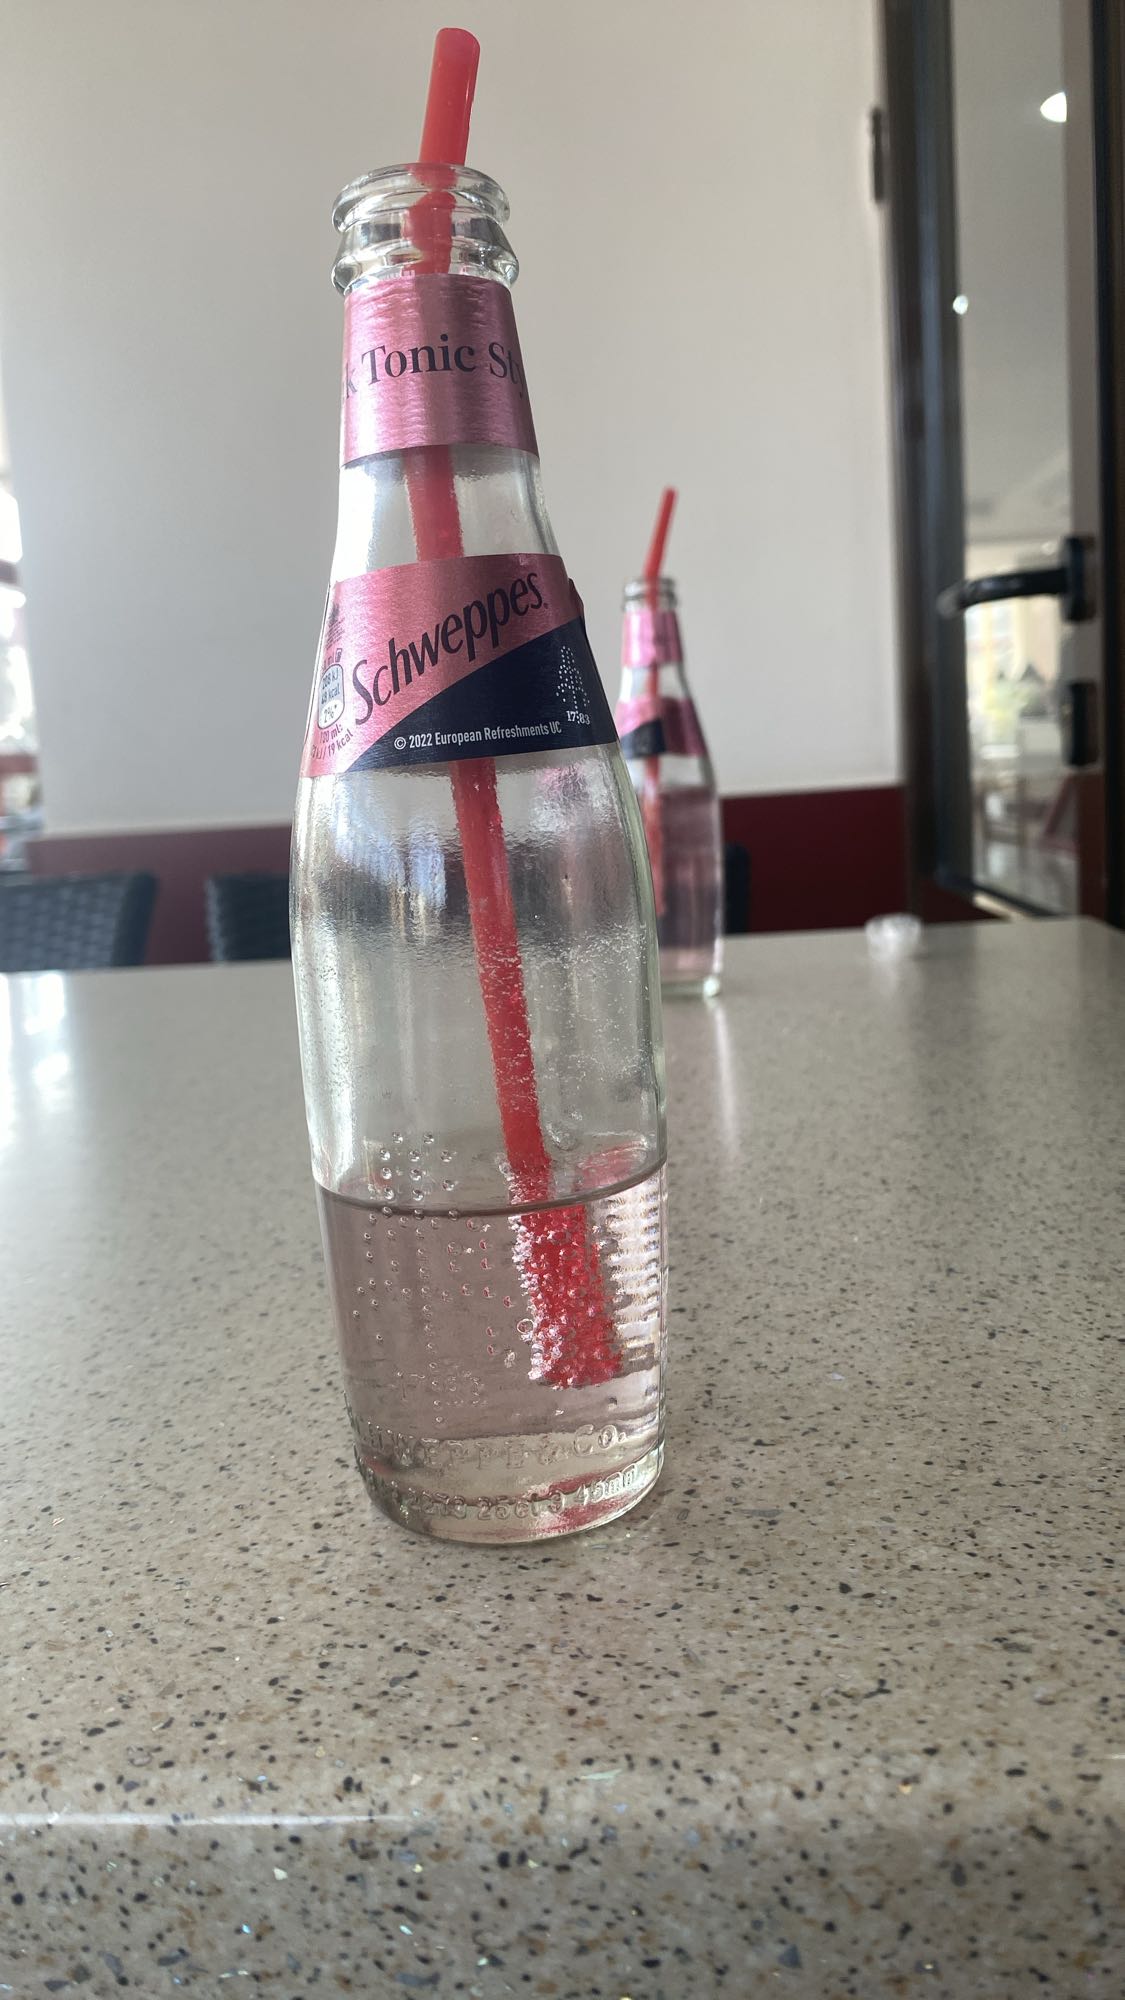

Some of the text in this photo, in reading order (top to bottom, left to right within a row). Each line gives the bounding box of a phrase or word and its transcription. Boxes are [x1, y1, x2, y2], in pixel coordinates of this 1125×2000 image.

[361, 334, 476, 386] Tonic
[352, 572, 543, 726] Schweppes
[336, 728, 354, 751] kcal
[409, 733, 433, 749] 2022
[435, 730, 482, 746] European
[484, 723, 549, 740] Refreshments
[549, 721, 562, 734] UC
